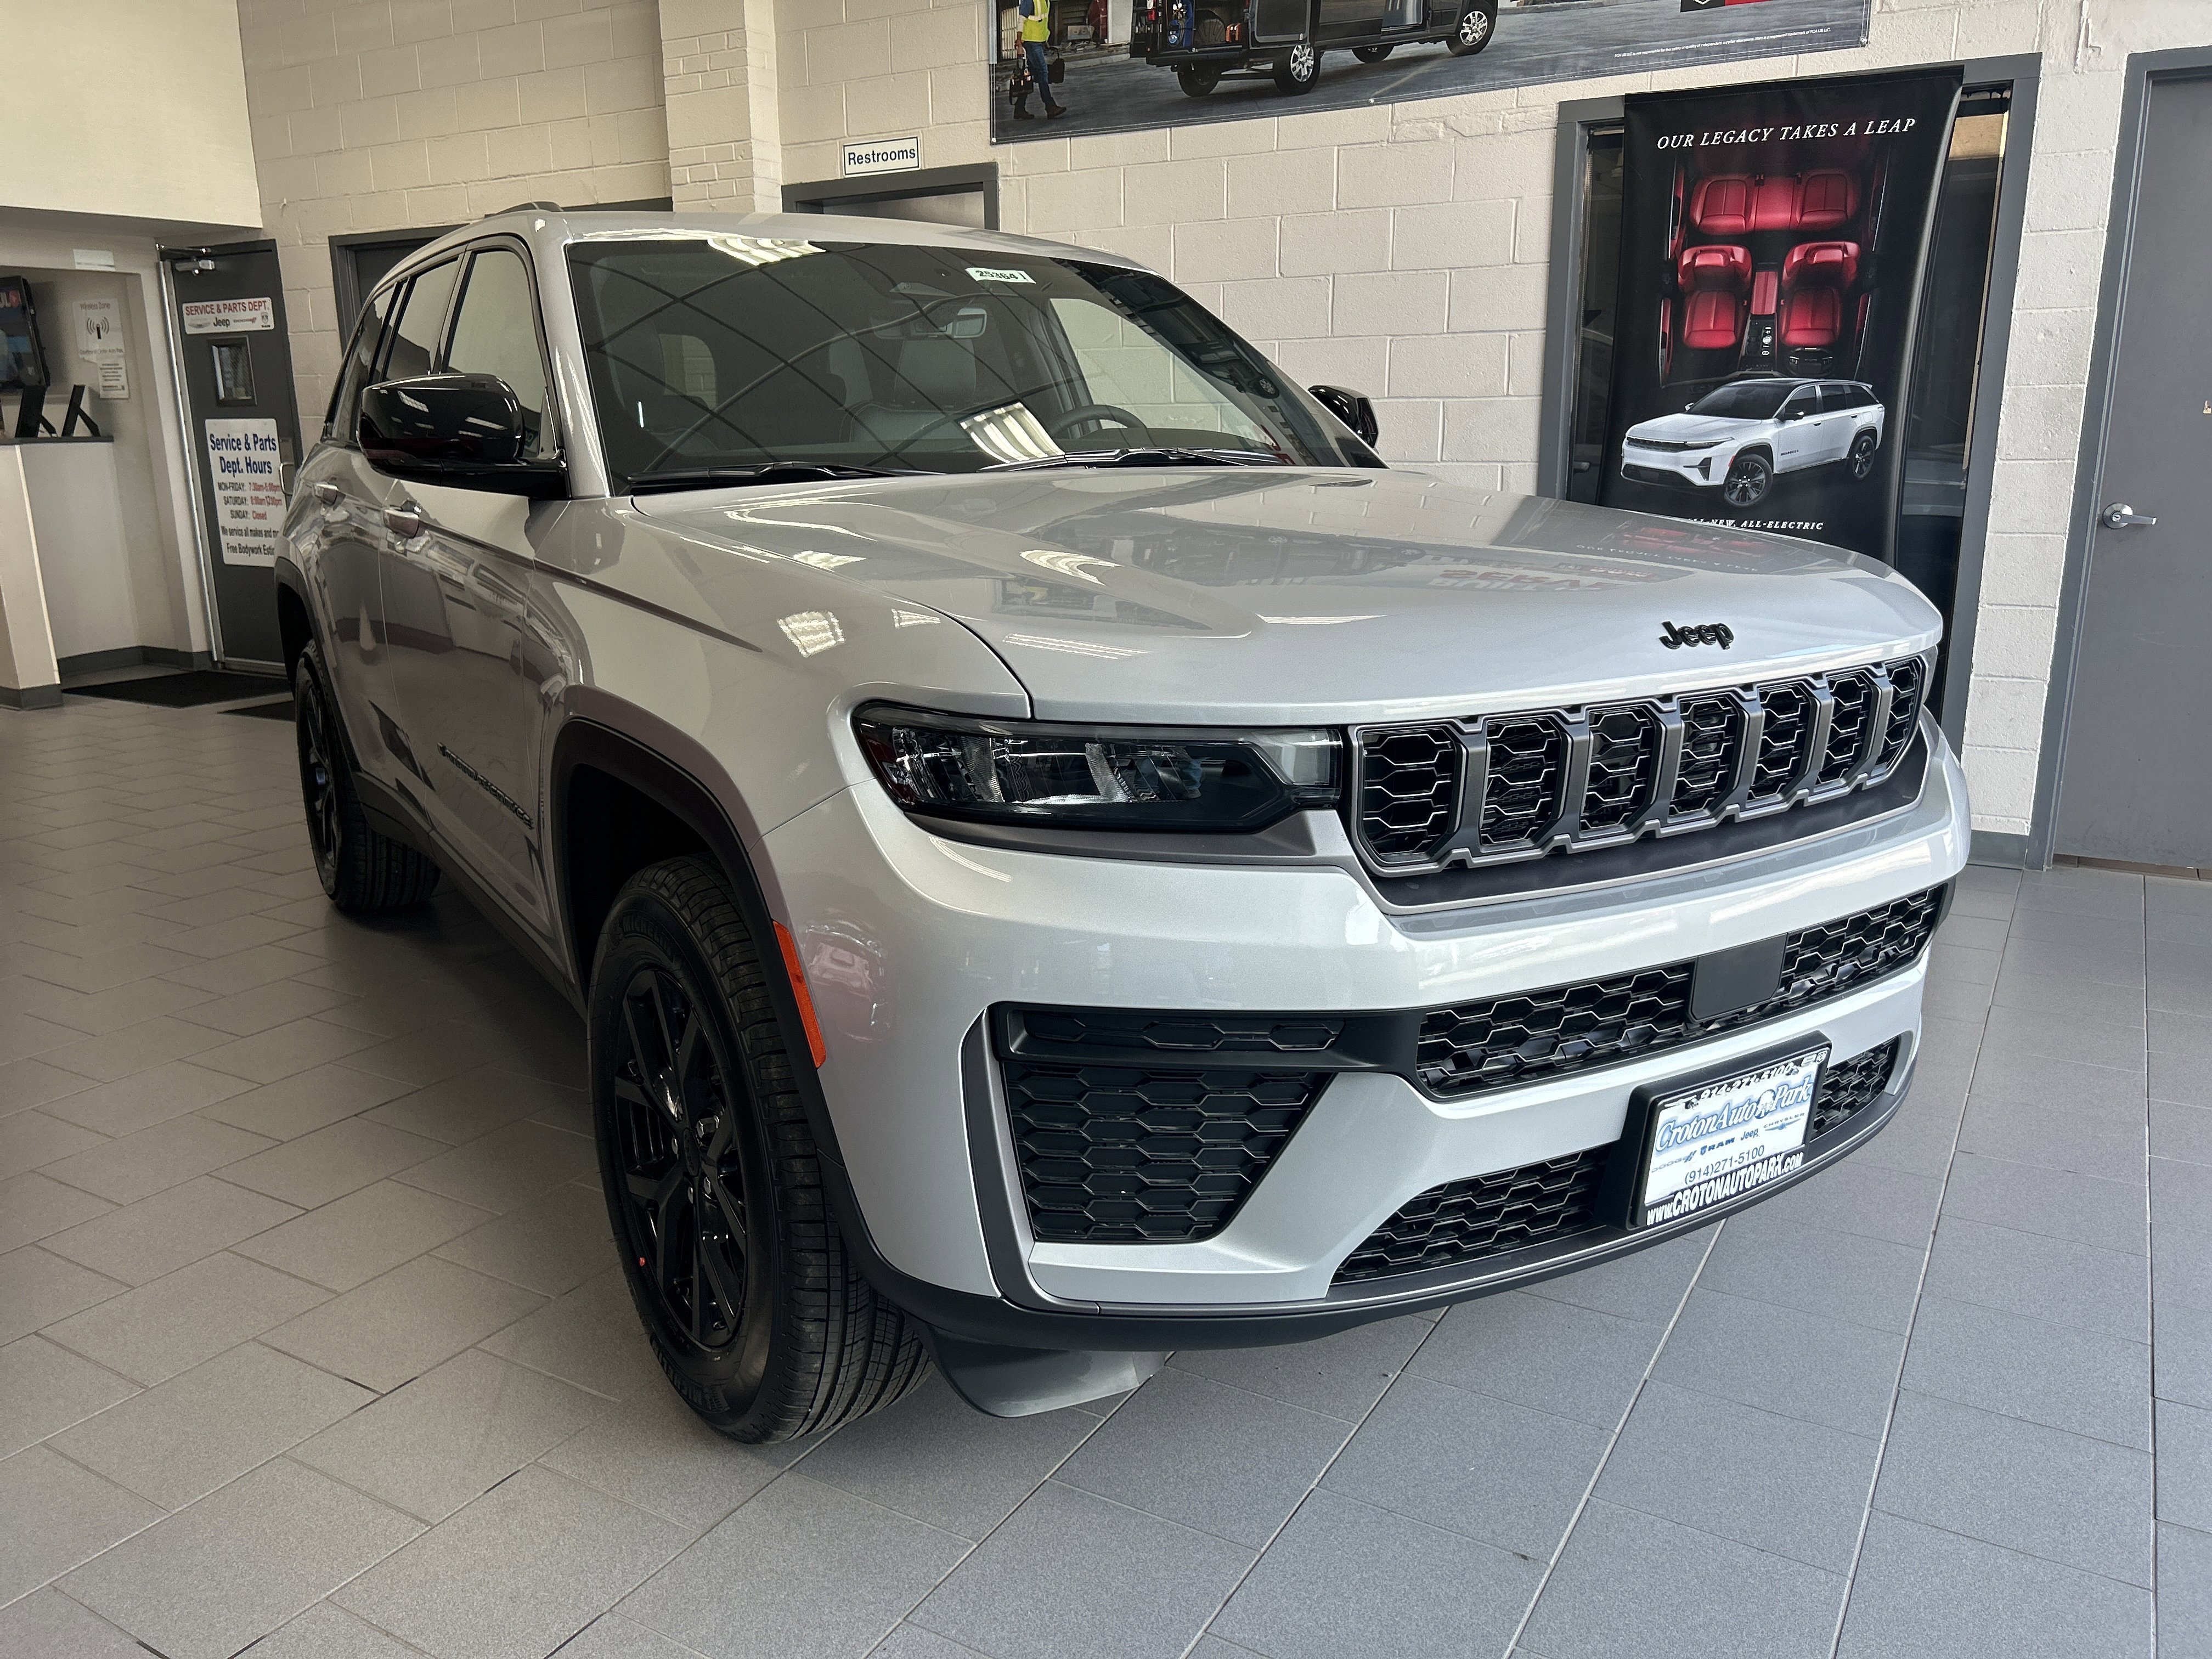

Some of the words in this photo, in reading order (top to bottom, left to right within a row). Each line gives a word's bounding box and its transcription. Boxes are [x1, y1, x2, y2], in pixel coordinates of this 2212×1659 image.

[1657, 134, 1694, 149] OUR
[1700, 127, 1774, 146] LEGACY
[1780, 123, 1839, 141] TAKES
[1843, 122, 1857, 136] A
[1864, 117, 1917, 135] LEAP
[848, 148, 916, 165] Restrooms
[185, 304, 215, 316] SERVICE
[217, 303, 222, 313] &
[223, 302, 246, 313] PARTS
[248, 301, 269, 312] DEPT.
[213, 317, 230, 328] Jeep
[210, 433, 241, 450] Service
[245, 433, 251, 450] &
[253, 433, 276, 451] Parts
[219, 456, 243, 478] Dept.
[245, 456, 272, 474] Hours
[223, 496, 249, 506] SATURDAY:
[230, 510, 250, 520] SUNDAY:
[252, 510, 267, 520] Closed
[229, 527, 244, 537] service
[1740, 520, 1824, 530] ALL-ELECTRIC
[227, 543, 238, 554] Free
[238, 543, 263, 557] Bodywork
[1659, 621, 1734, 650] Jeep
[1708, 1137, 1735, 1152] RAM
[1741, 1128, 1758, 1141] Jeep
[1763, 1113, 1805, 1128] CHRYSLER
[1685, 1144, 1765, 1185] (914)271-5100
